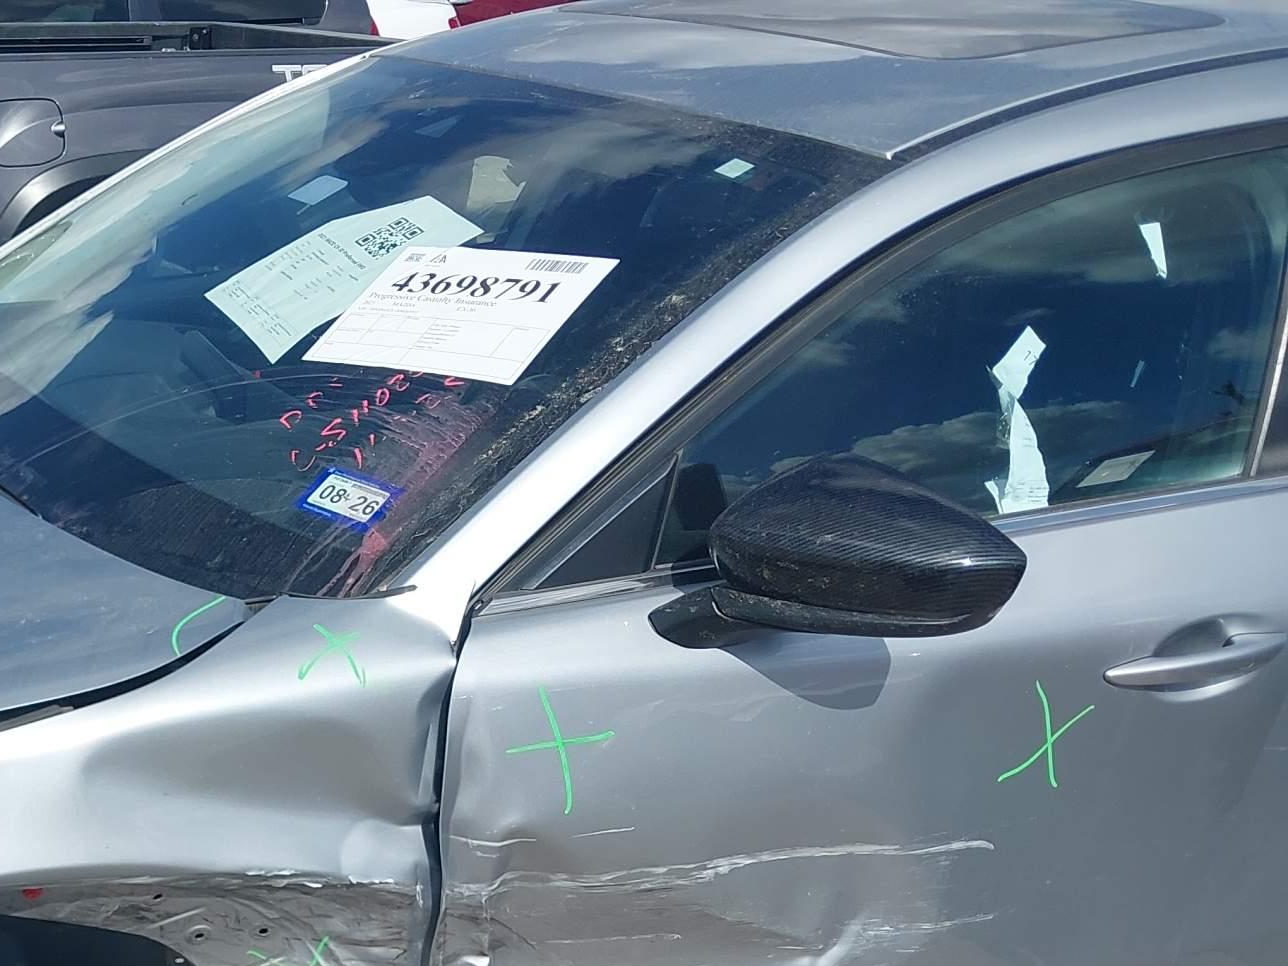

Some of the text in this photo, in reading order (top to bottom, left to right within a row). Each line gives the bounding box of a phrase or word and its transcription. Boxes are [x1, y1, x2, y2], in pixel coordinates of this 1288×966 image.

[392, 272, 561, 303] 43698791
[319, 485, 347, 503] 08
[349, 496, 379, 515] 26
